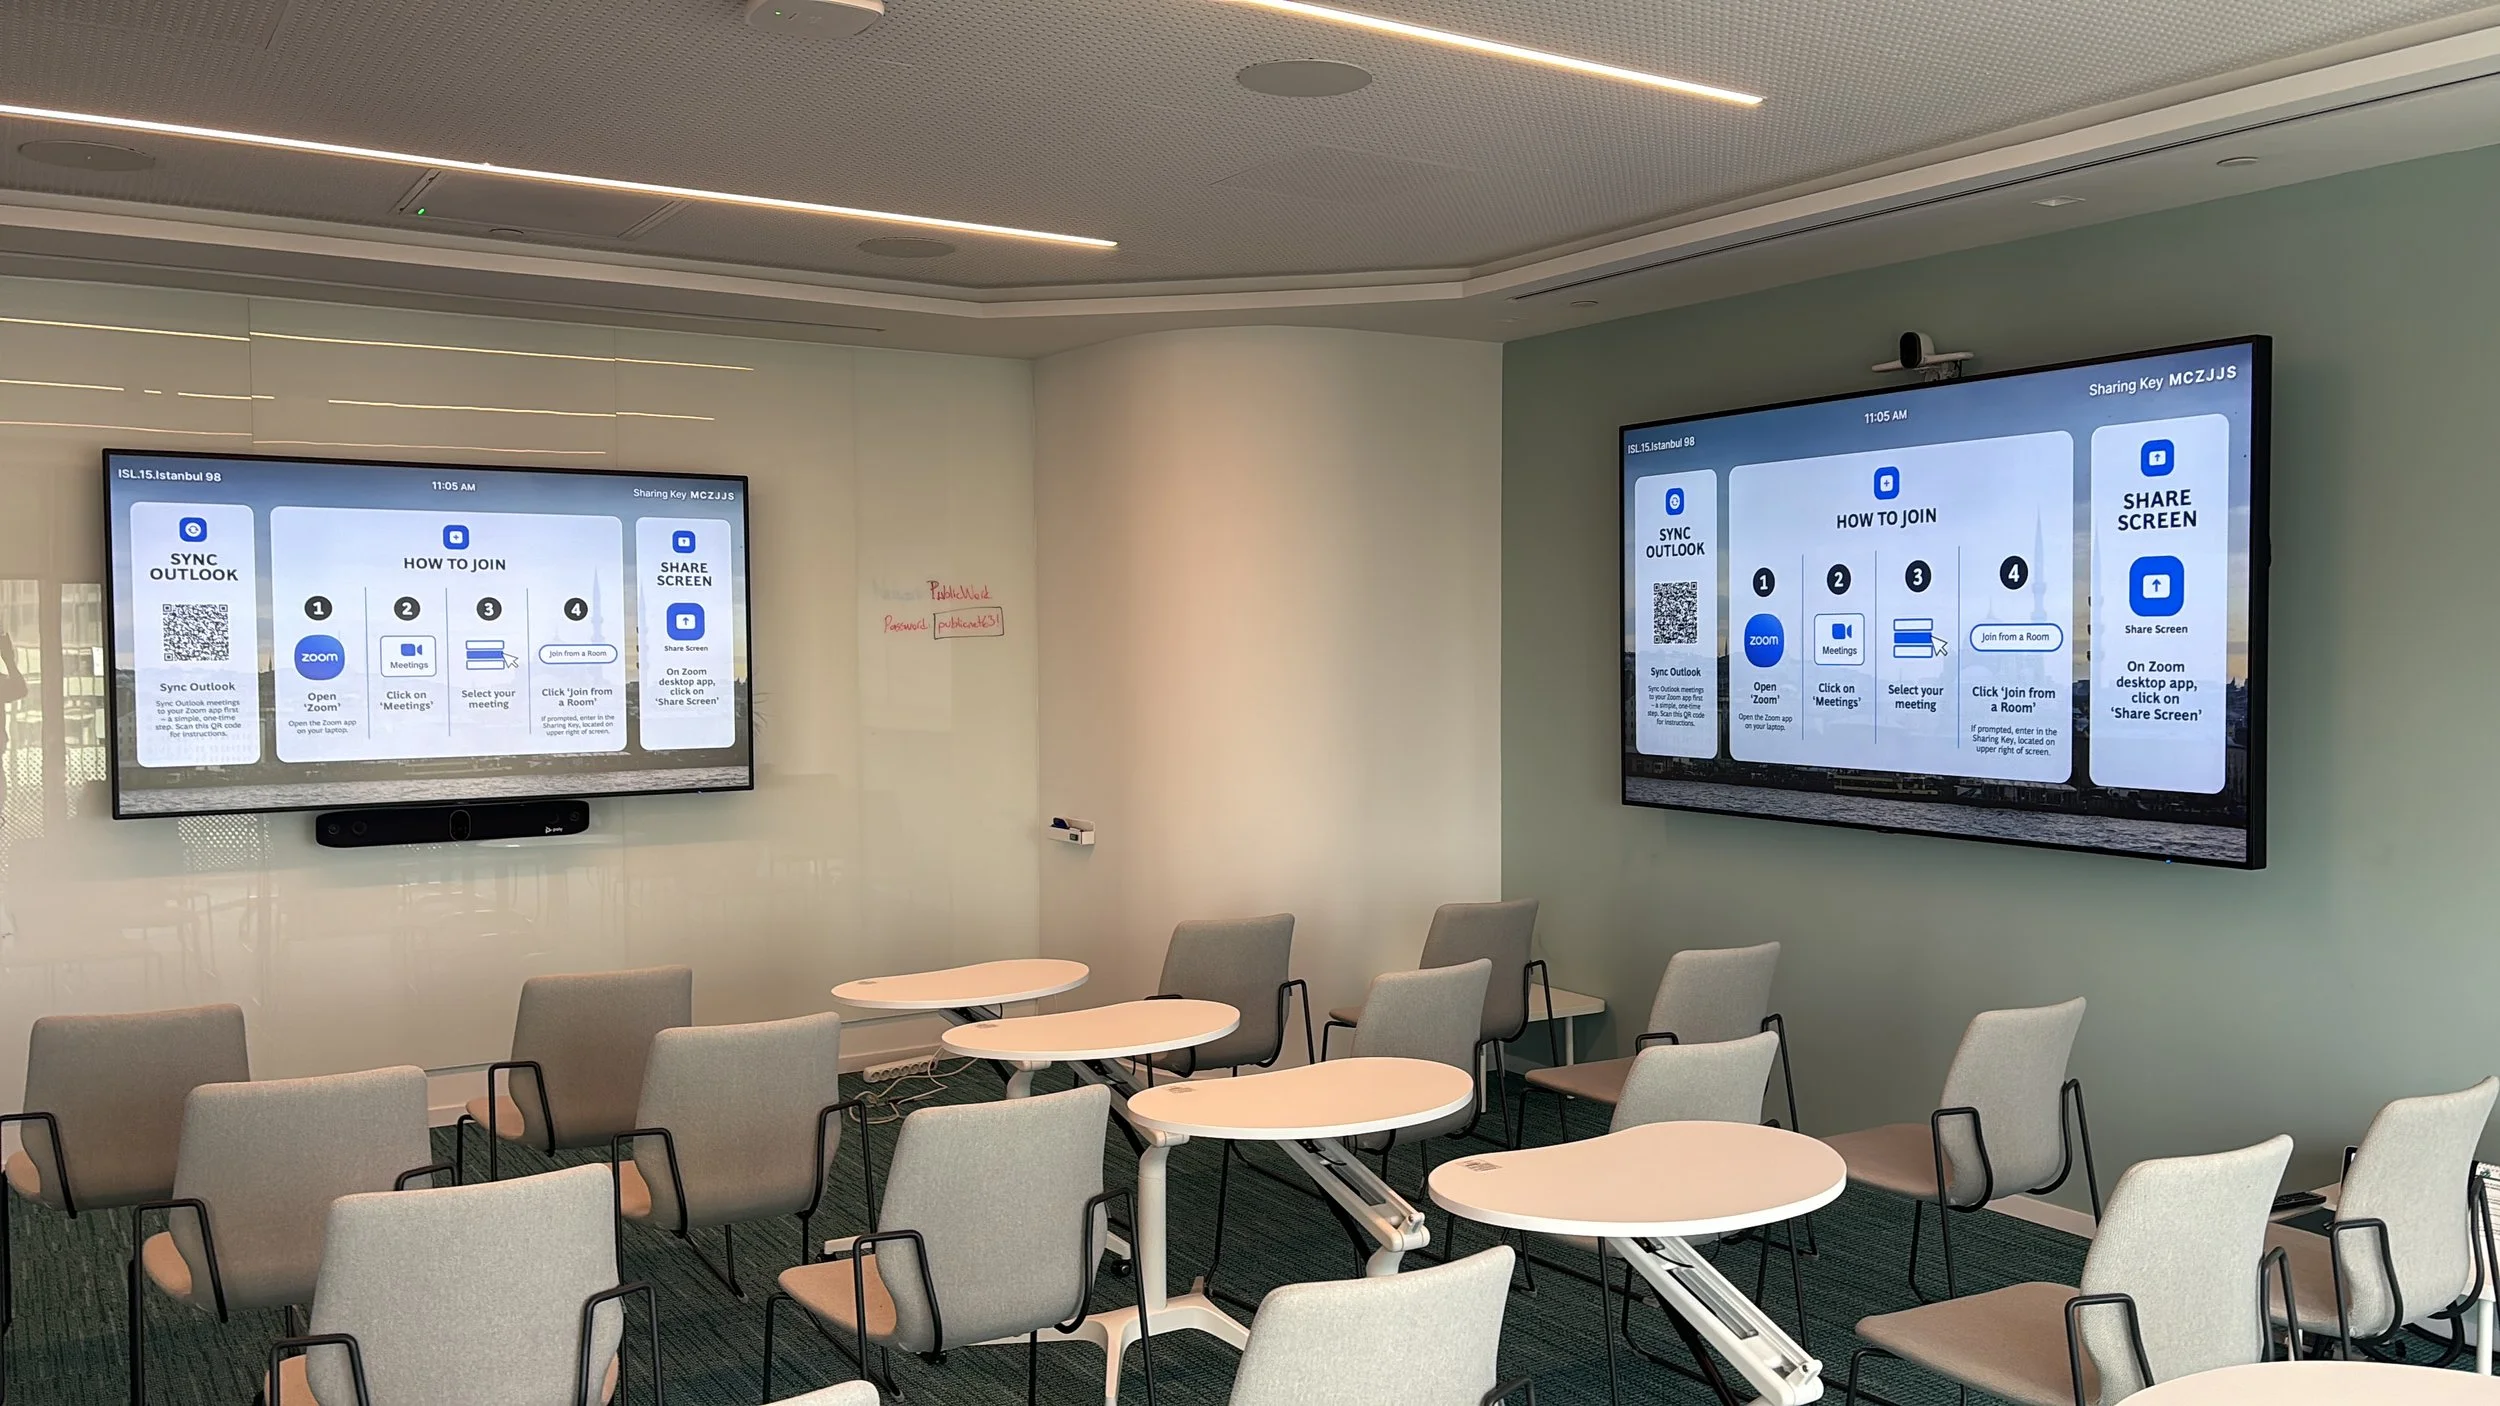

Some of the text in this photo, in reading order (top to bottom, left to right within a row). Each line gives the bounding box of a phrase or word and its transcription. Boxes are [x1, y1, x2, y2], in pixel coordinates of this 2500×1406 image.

[2089, 365, 2237, 396] Sharing Key MCZJJS
[1864, 409, 1908, 424] 11:05 AM
[1627, 436, 1695, 454] ISL.15.Istanbul 98
[118, 469, 222, 482] ISL.15.Istanbul 98
[432, 481, 476, 491] 11:05 AM
[633, 488, 735, 500] Sharing Key MCZJJS
[2123, 489, 2192, 510] SHARE
[1836, 508, 1937, 529] HOW TO JOIN
[2117, 510, 2197, 531] SCREEN
[1659, 526, 1691, 541] SYNC
[1646, 542, 1705, 558] OUTLOOK
[170, 553, 218, 566] SYNC
[404, 557, 506, 573] HOW TO JOIN
[660, 562, 708, 573] SHARE
[2008, 563, 2020, 583] 4
[150, 568, 239, 581] OUTLOOK
[1834, 571, 1844, 588] 2
[1912, 567, 1923, 586] 3
[657, 575, 712, 587] SCREEN
[1759, 575, 1768, 590] 1
[312, 601, 324, 615] 1
[401, 602, 413, 616] 2
[484, 602, 494, 616] 3
[570, 603, 582, 616] 4
[2125, 625, 2188, 634] Share Screen
[1749, 635, 1779, 646] zoom
[1981, 632, 1997, 643] Join
[1998, 632, 2017, 641] from
[2026, 632, 2050, 641] Room
[301, 652, 339, 662] zoom
[549, 650, 563, 659] Join
[1822, 646, 1858, 657] Meetings
[390, 661, 429, 670] Meetings
[2127, 661, 2185, 673] On Zoom
[666, 668, 707, 676] On Zoom
[1650, 667, 1702, 678] Sync Outlook
[160, 682, 236, 693] Sync Outlook
[658, 677, 716, 687] desktop app,
[1753, 681, 1777, 693] Open
[1818, 683, 1855, 693] Click on
[2116, 676, 2198, 691] desktop app,
[386, 691, 412, 700] Click
[461, 689, 516, 699] Select your
[541, 688, 565, 697] Click
[590, 687, 613, 696] from
[670, 687, 691, 695] click
[1647, 685, 1659, 693] Sync
[1680, 686, 1704, 694] meetings
[1888, 684, 1944, 699] Select your
[1972, 686, 1999, 697] Click
[2028, 687, 2056, 699] from
[307, 692, 337, 703] Open
[2131, 692, 2180, 704] click on
[468, 699, 510, 709] meeting
[1895, 699, 1937, 713] meeting
[1990, 703, 1998, 712] a
[1738, 713, 1793, 723] Open the Zoom app
[1753, 723, 1766, 731] your
[1766, 722, 1786, 732] laptop.
[1977, 725, 2014, 735] prompted,
[2015, 727, 2035, 735] enter
[2045, 728, 2058, 736] the
[1972, 734, 2055, 746] Sharing Key, located on
[1976, 745, 2051, 756] upper right of screen.
